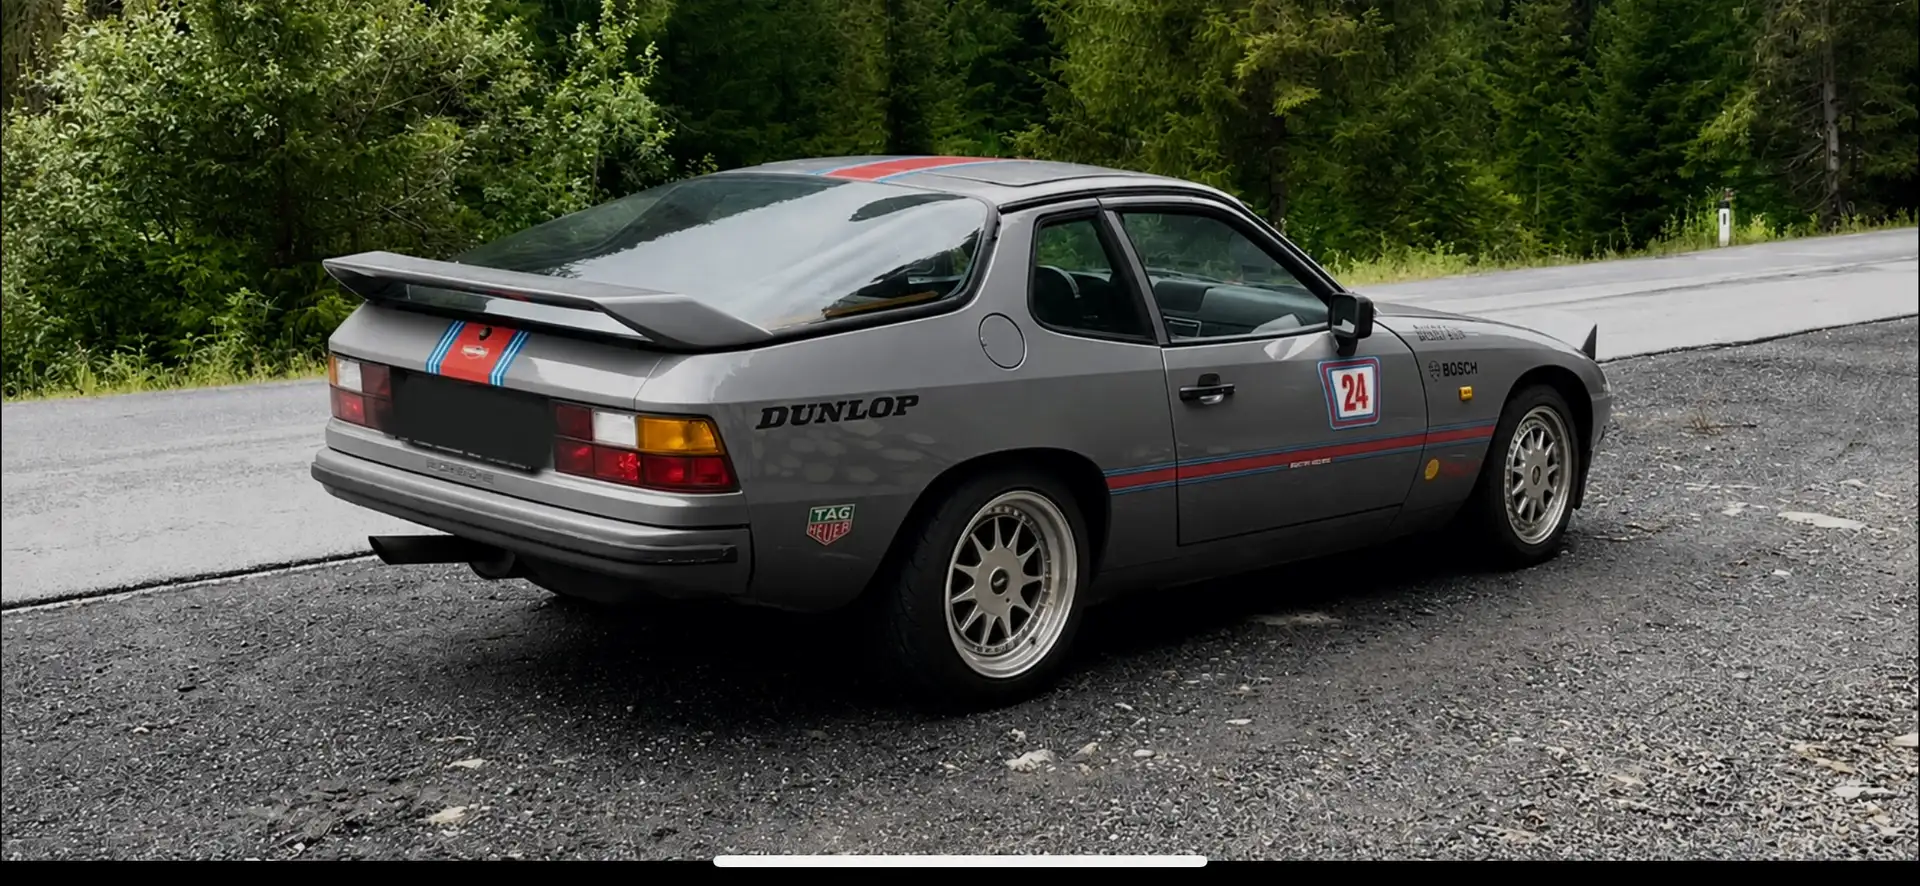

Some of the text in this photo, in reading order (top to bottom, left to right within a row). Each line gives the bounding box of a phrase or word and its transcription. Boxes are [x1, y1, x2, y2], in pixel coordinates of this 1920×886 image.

[1442, 361, 1478, 377] BOSCH
[1341, 372, 1369, 412] 24
[755, 394, 919, 430] DUNLOP
[814, 506, 851, 521] TAG
[809, 521, 850, 542] HEUER
